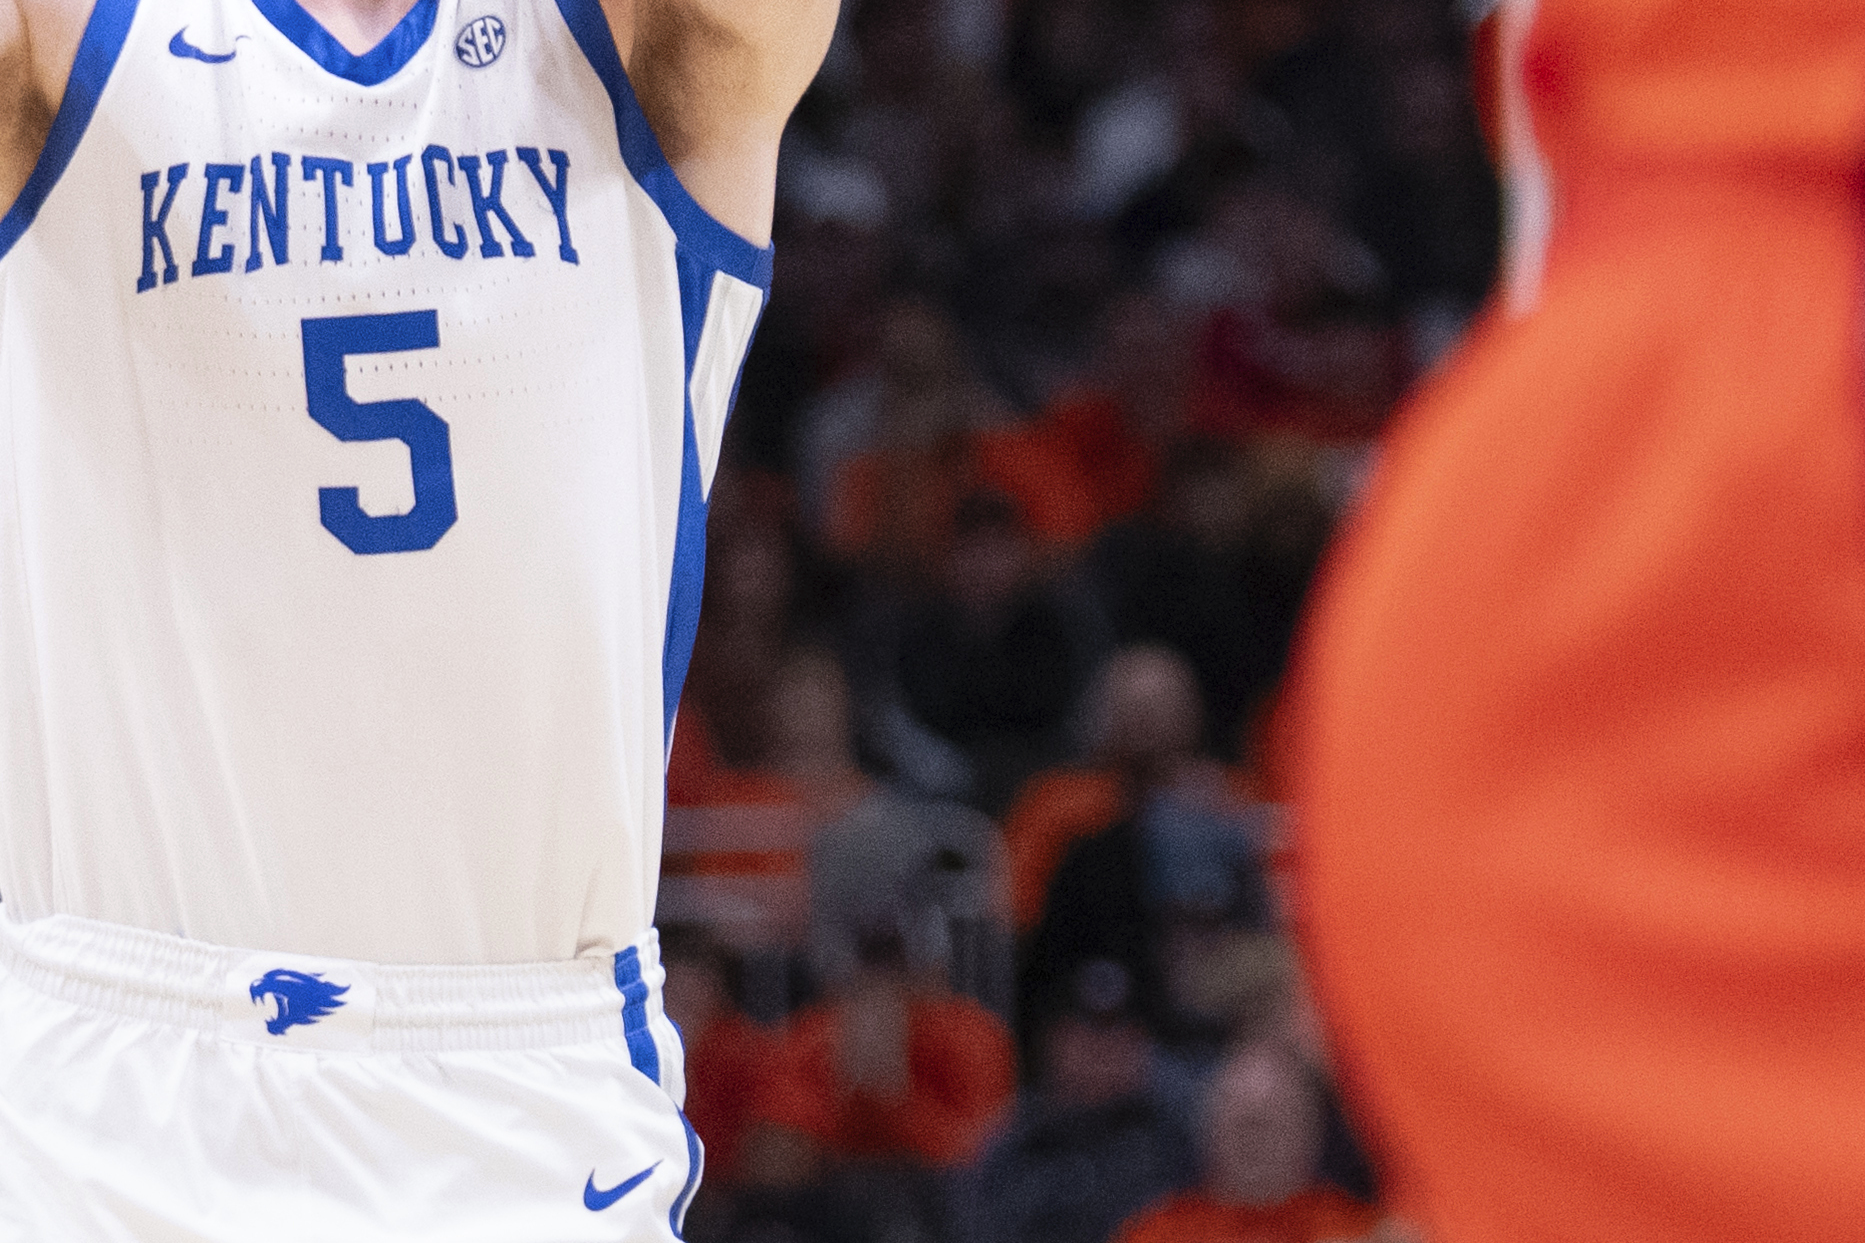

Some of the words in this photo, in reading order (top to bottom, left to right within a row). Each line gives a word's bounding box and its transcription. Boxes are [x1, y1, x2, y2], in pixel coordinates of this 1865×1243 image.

[456, 16, 506, 68] SEC
[136, 144, 579, 294] KENTUCKY
[301, 309, 458, 555] 5
